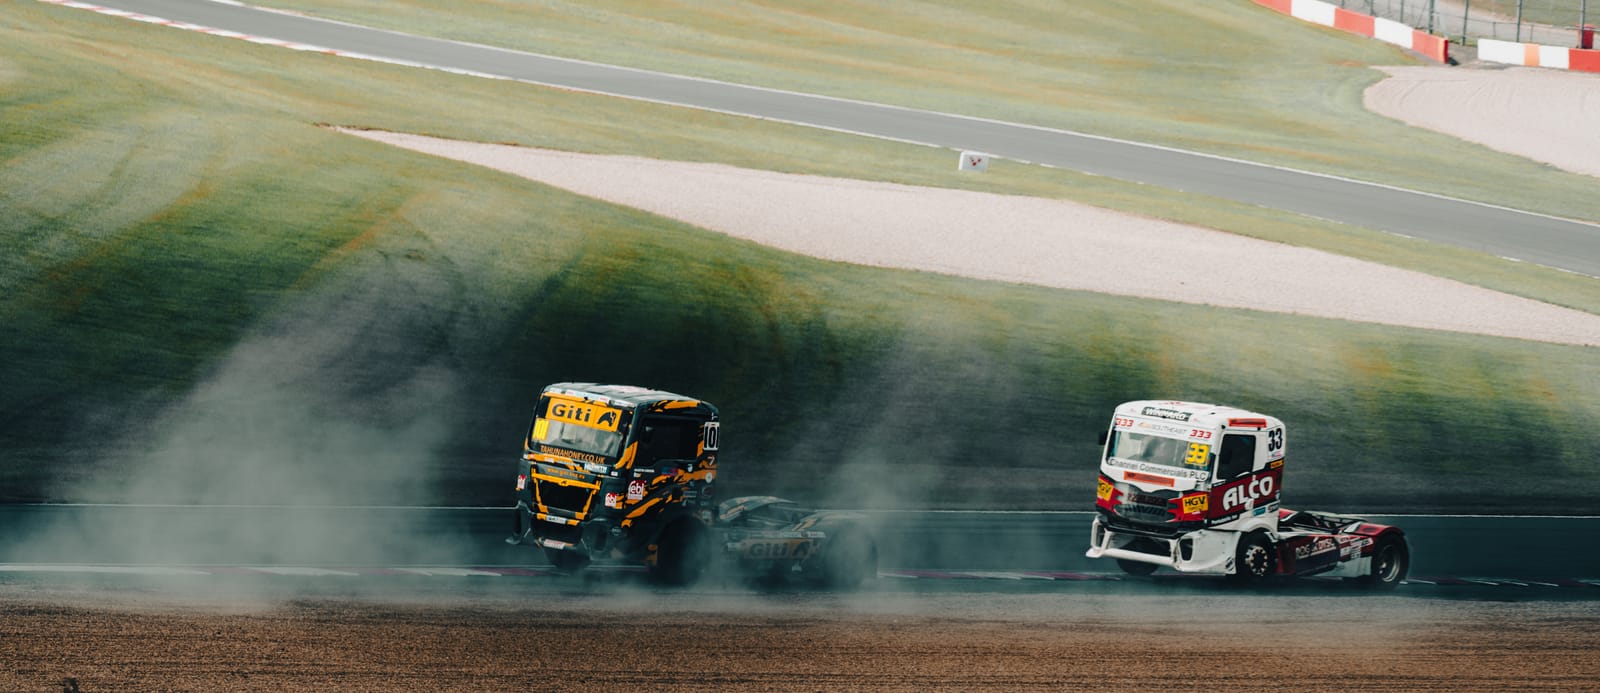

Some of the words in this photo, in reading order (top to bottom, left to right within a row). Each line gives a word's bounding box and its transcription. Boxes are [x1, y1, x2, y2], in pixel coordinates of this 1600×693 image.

[551, 403, 591, 422] Giti
[1115, 418, 1134, 427] 333
[704, 424, 719, 449] 101
[1189, 429, 1212, 439] 333
[1268, 427, 1283, 452] 33
[540, 445, 606, 464] TAHUNAHONEY.CO.UK
[1186, 443, 1209, 465] 33
[1108, 458, 1138, 470] Channel
[1139, 463, 1188, 478] Commercials
[1189, 471, 1206, 480] PLC
[1184, 495, 1206, 506] HGV
[1222, 476, 1273, 511] ALCO
